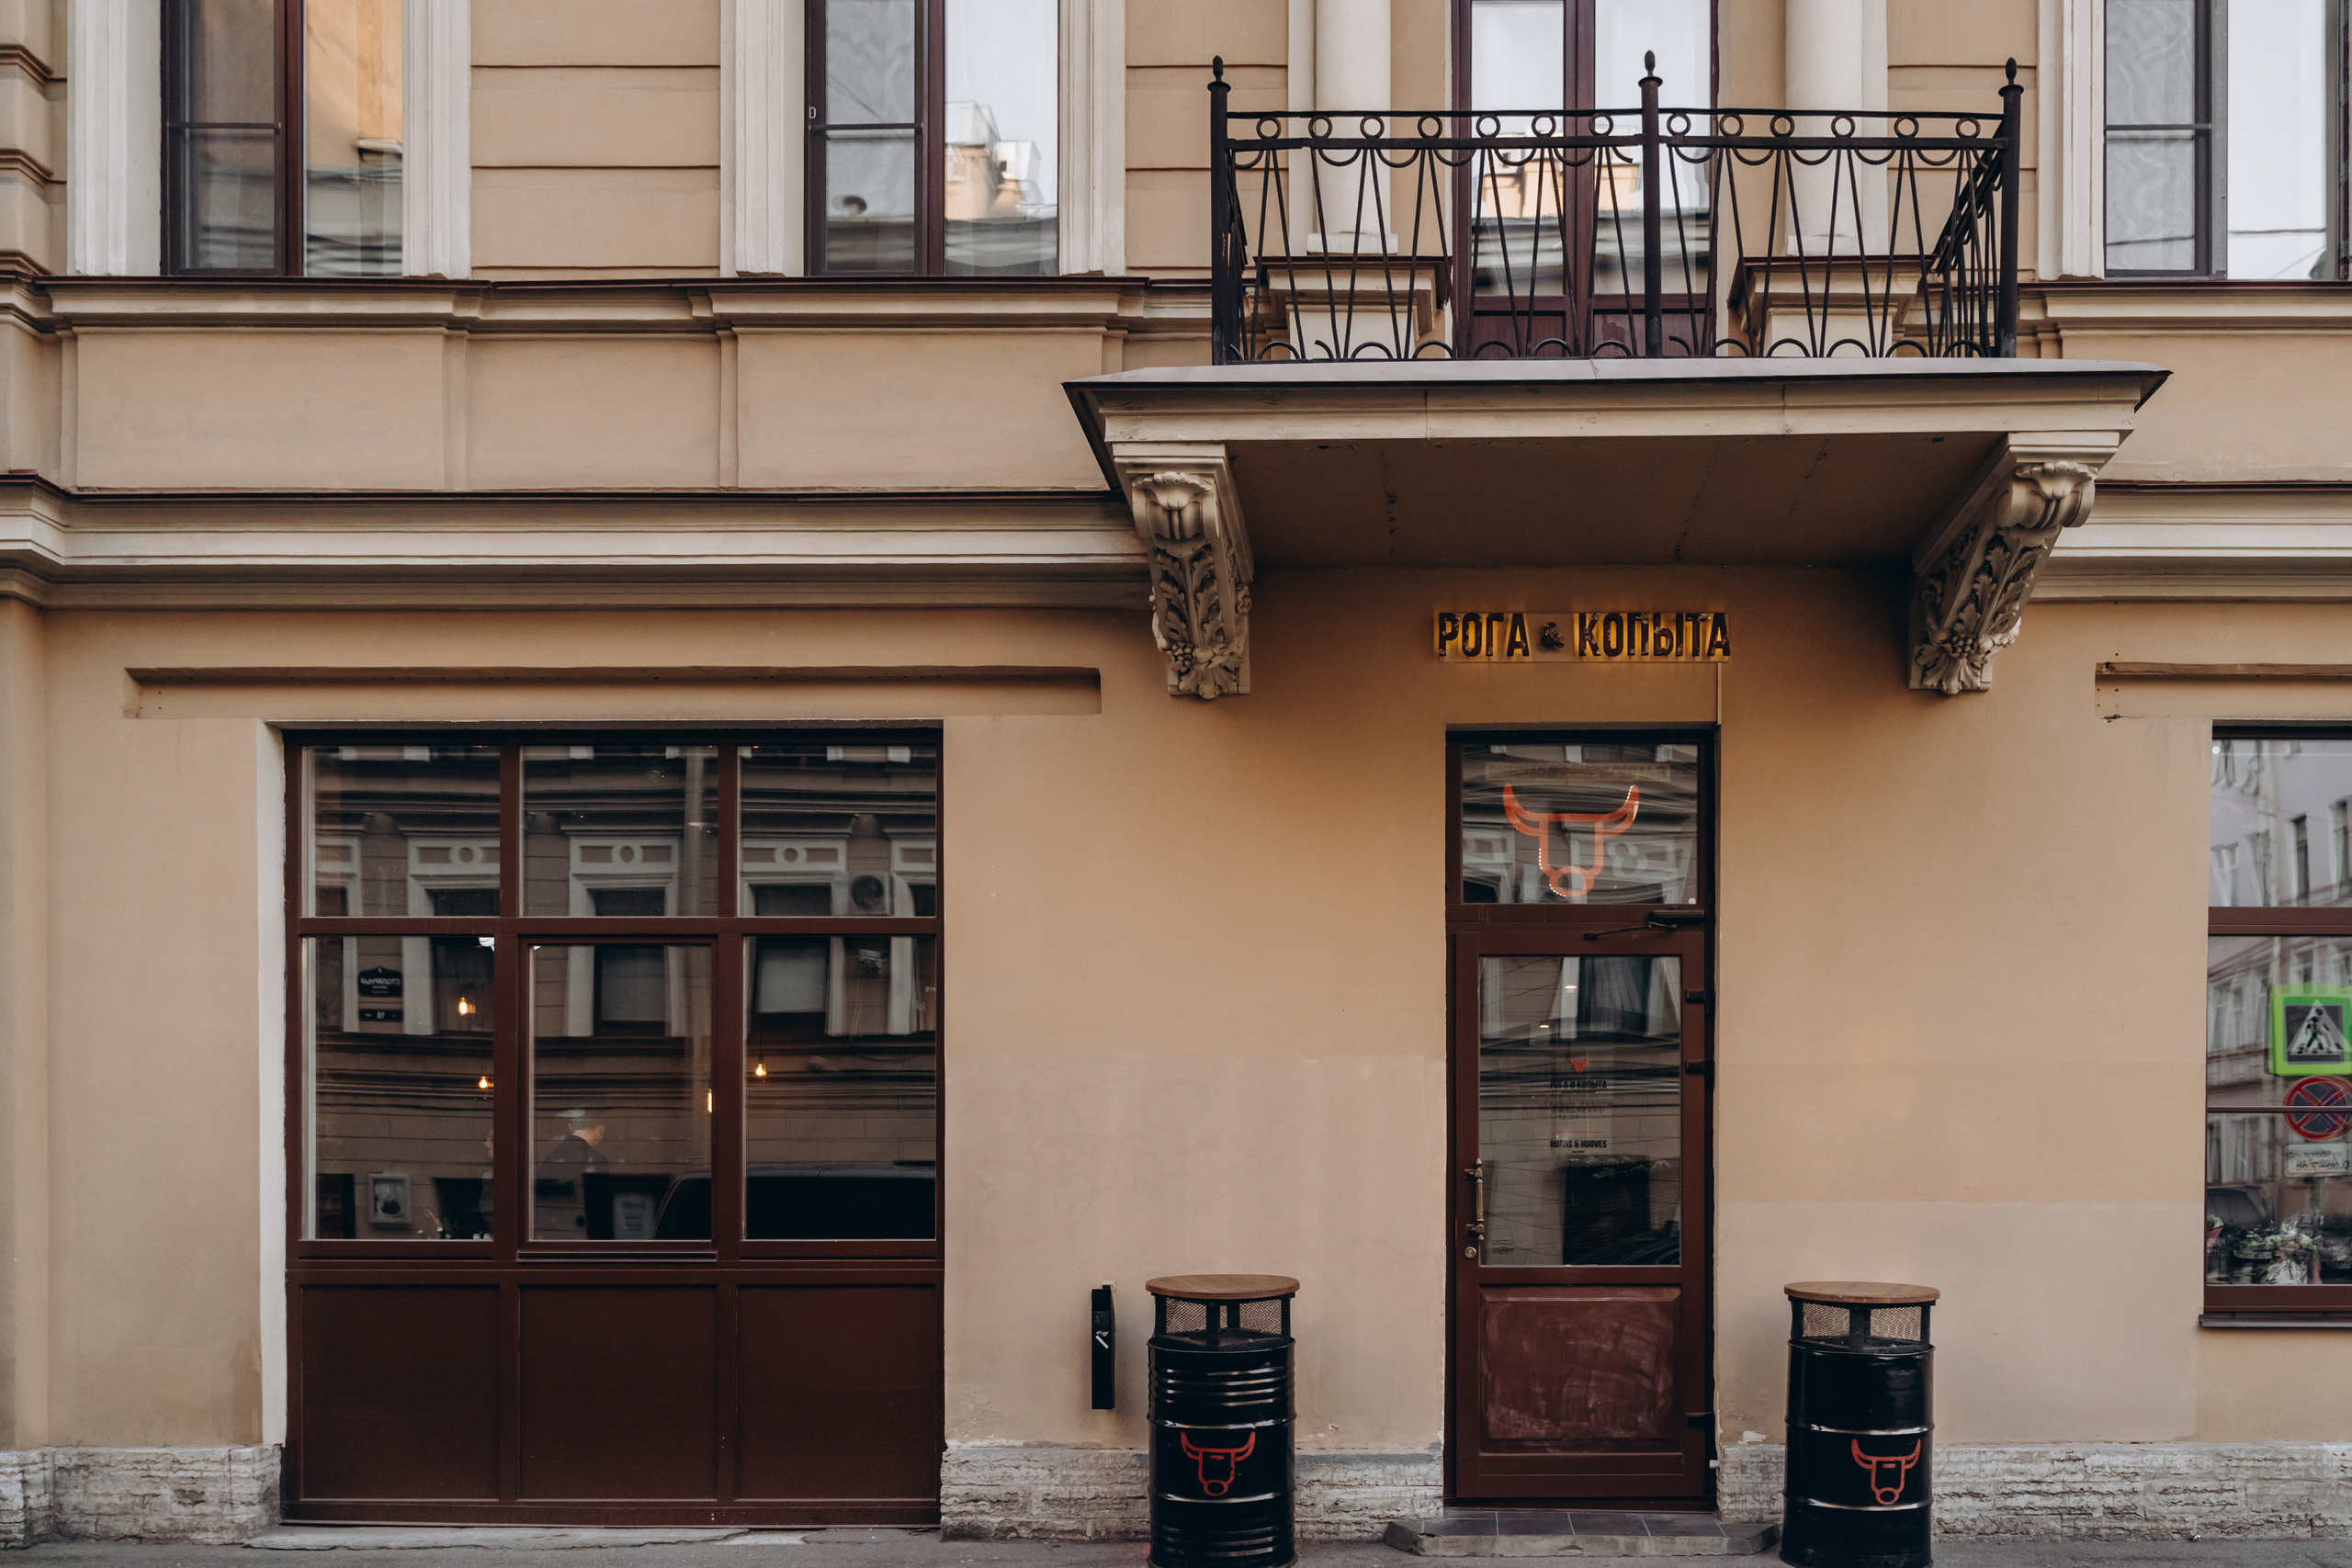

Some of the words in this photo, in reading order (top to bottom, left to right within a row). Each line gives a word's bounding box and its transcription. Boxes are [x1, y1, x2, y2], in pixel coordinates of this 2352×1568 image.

[1438, 613, 1530, 657] РОГА
[1541, 621, 1565, 649] &
[1578, 613, 1731, 657] КОПЫТА
[1550, 1079, 1568, 1089] РОГА
[1570, 1079, 1576, 1089] И
[1577, 1079, 1607, 1089] КОПЫТА
[1574, 1140, 1579, 1148] &
[1580, 1140, 1607, 1148] HOOVES
